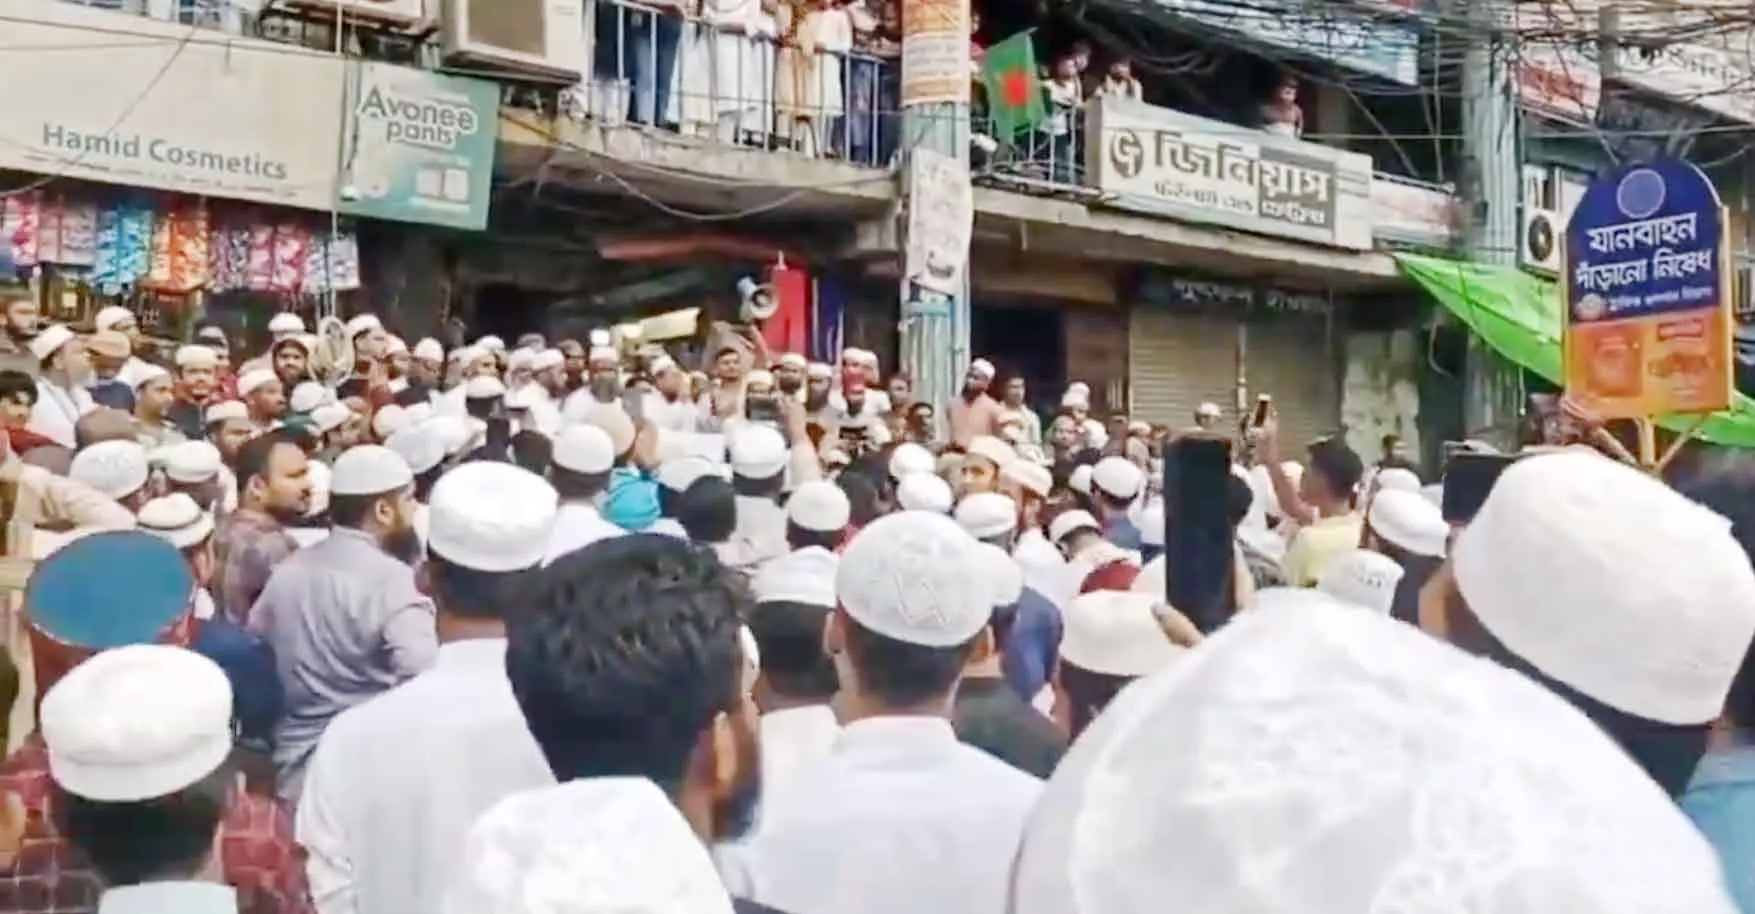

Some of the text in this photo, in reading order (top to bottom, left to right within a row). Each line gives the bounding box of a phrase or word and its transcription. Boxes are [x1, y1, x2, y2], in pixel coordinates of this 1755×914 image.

[361, 84, 473, 130] Avonee
[42, 123, 141, 158] Hamid
[148, 139, 288, 180] Cosmetics
[387, 120, 452, 145] pants
[1586, 212, 1697, 253] যানবাহন
[1652, 247, 1713, 281] নিষেধ
